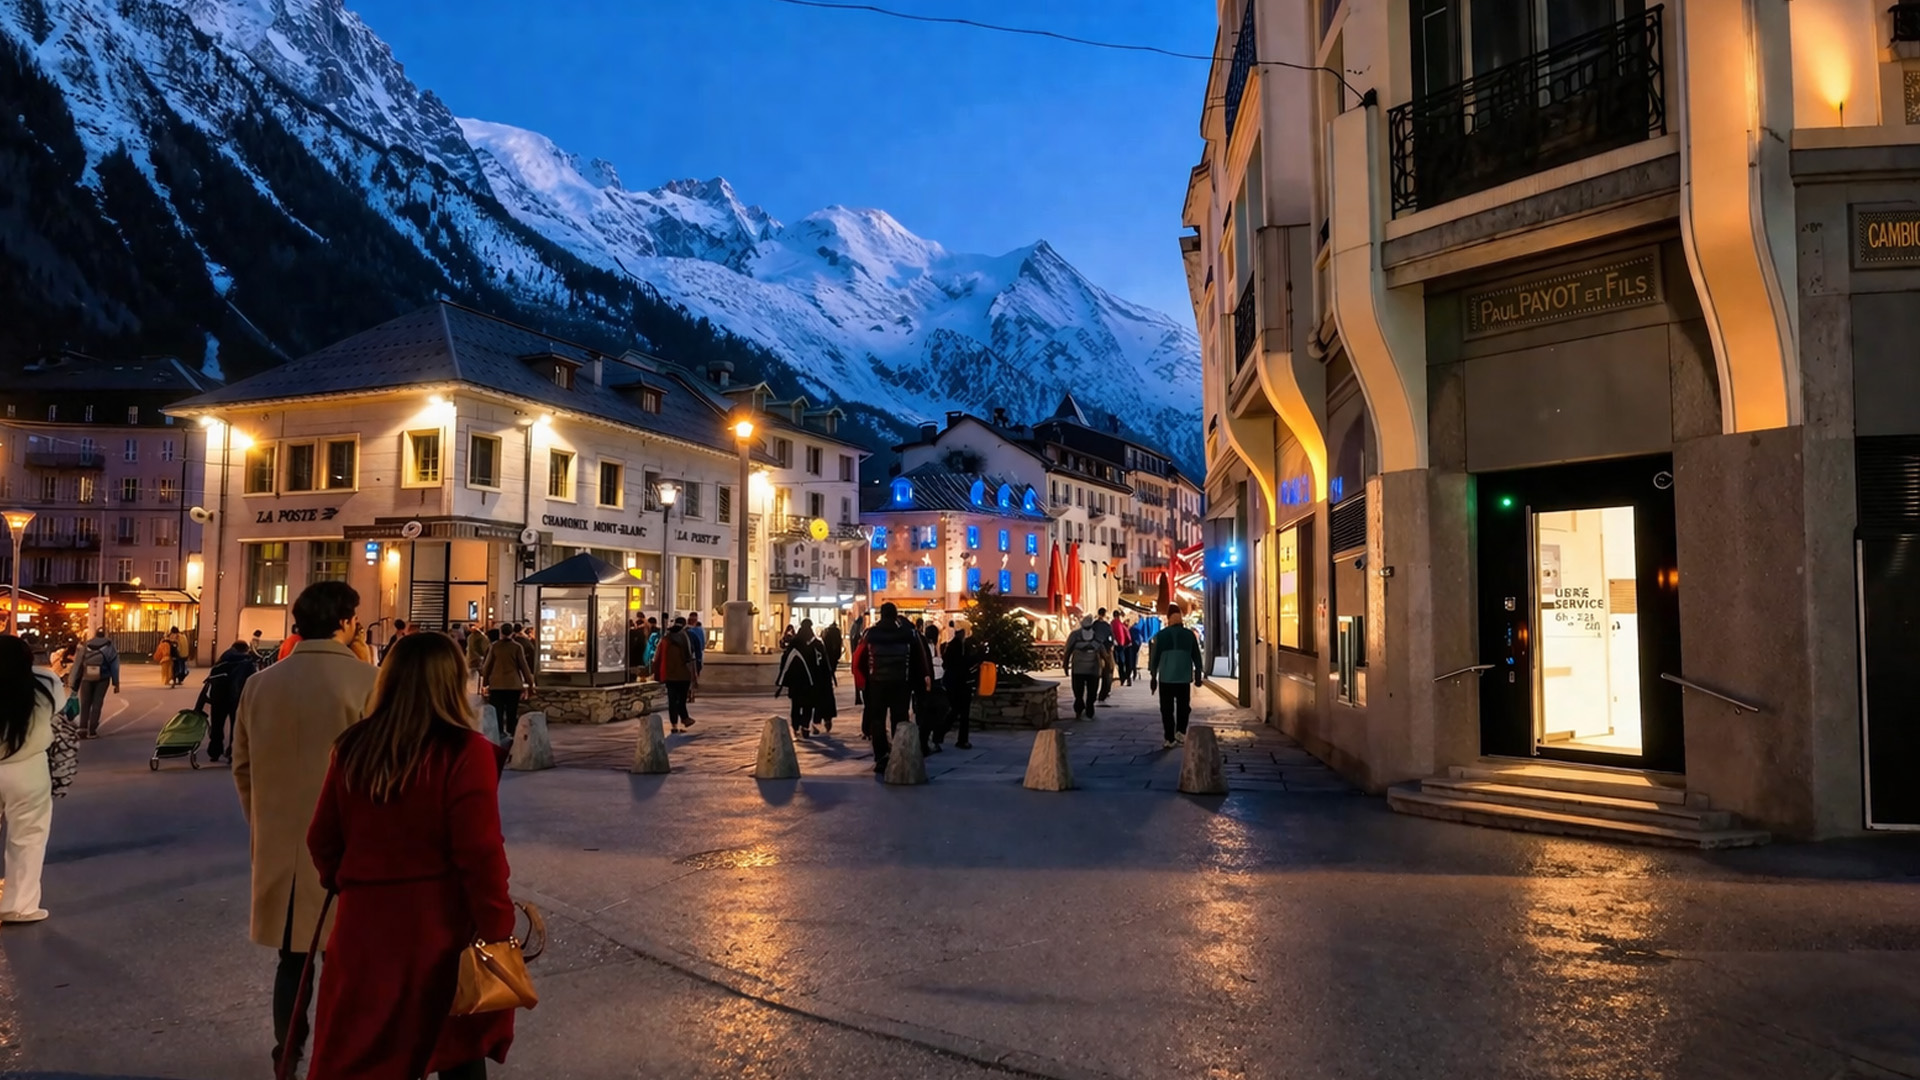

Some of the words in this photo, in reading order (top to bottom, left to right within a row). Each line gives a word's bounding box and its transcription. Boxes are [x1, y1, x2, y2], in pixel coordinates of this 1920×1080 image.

[1520, 282, 1581, 316] PAYOT
[256, 510, 273, 523] LA
[277, 508, 319, 522] POSTE
[542, 514, 589, 530] CHAMONIX
[1555, 599, 1604, 609] SERVICE
